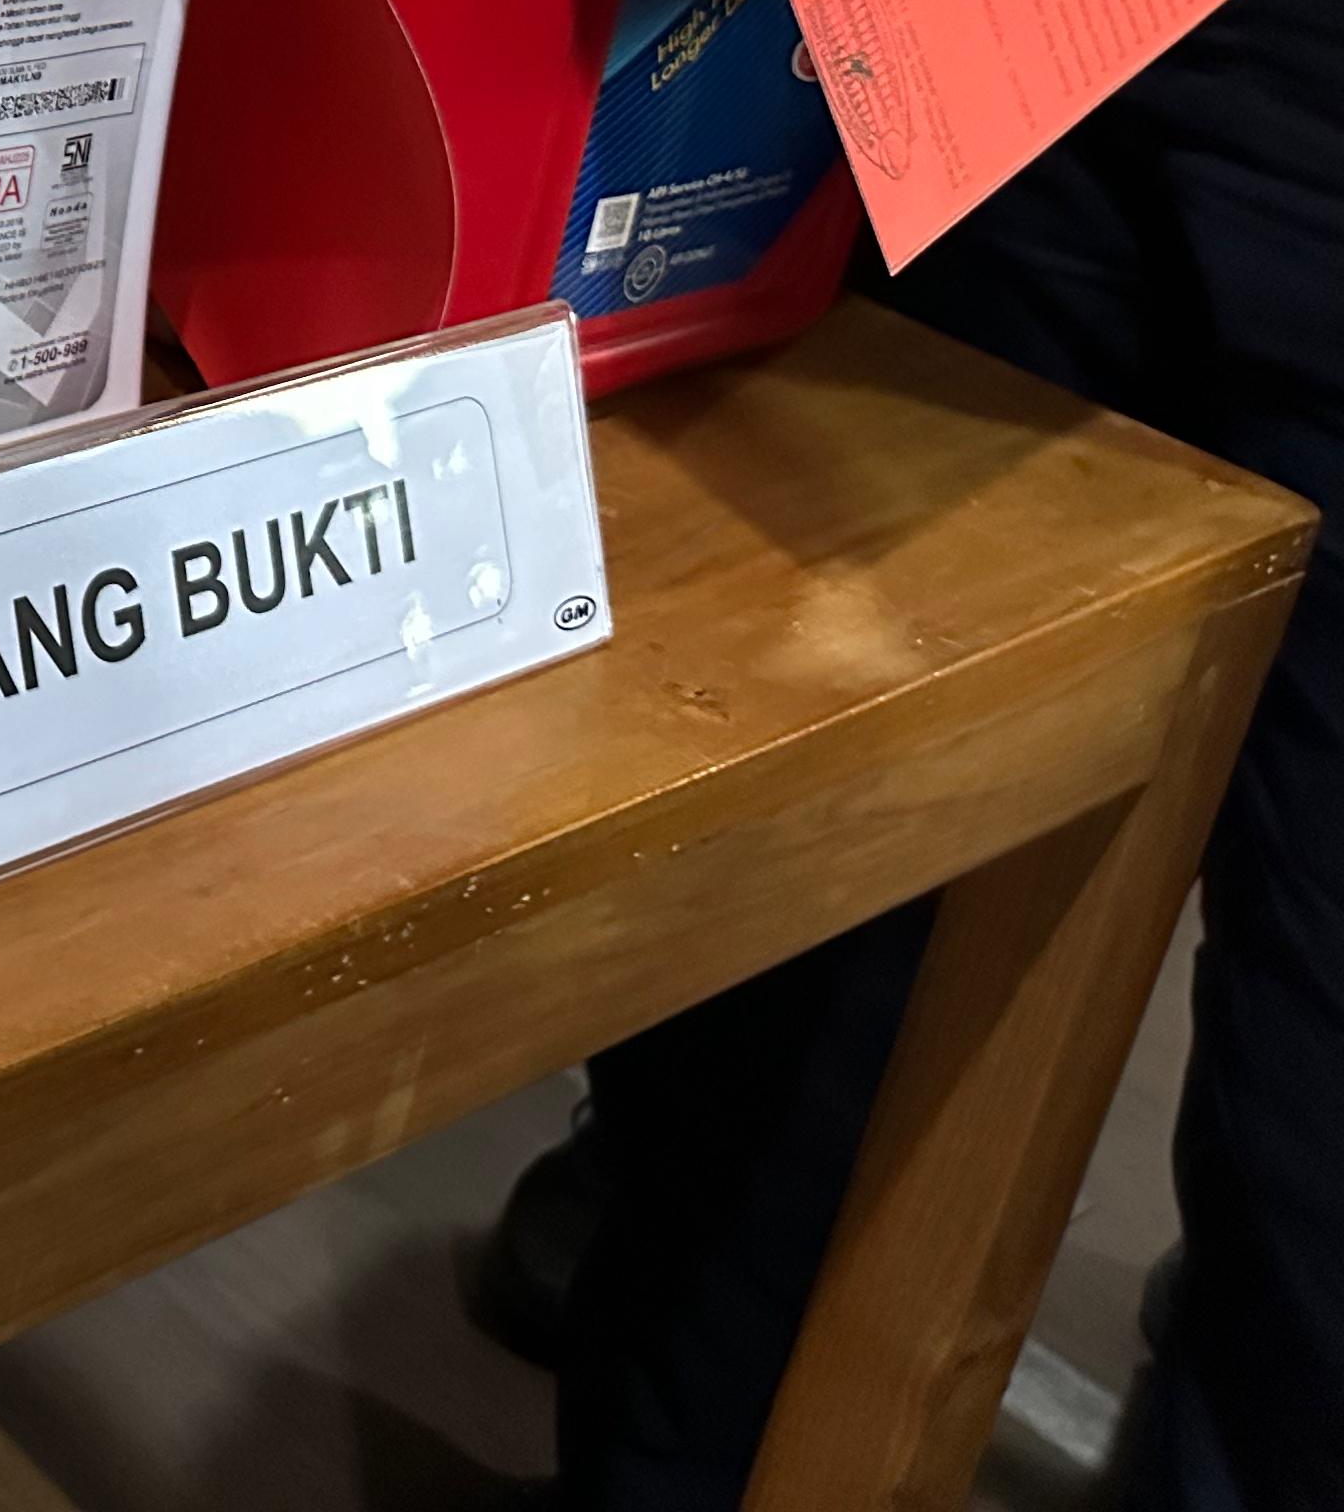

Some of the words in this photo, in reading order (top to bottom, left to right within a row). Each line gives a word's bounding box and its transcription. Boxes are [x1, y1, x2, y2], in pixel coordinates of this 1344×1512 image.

[63, 136, 93, 169] SNI
[20, 339, 89, 370] 1-500-989
[171, 477, 419, 640] BUKTI
